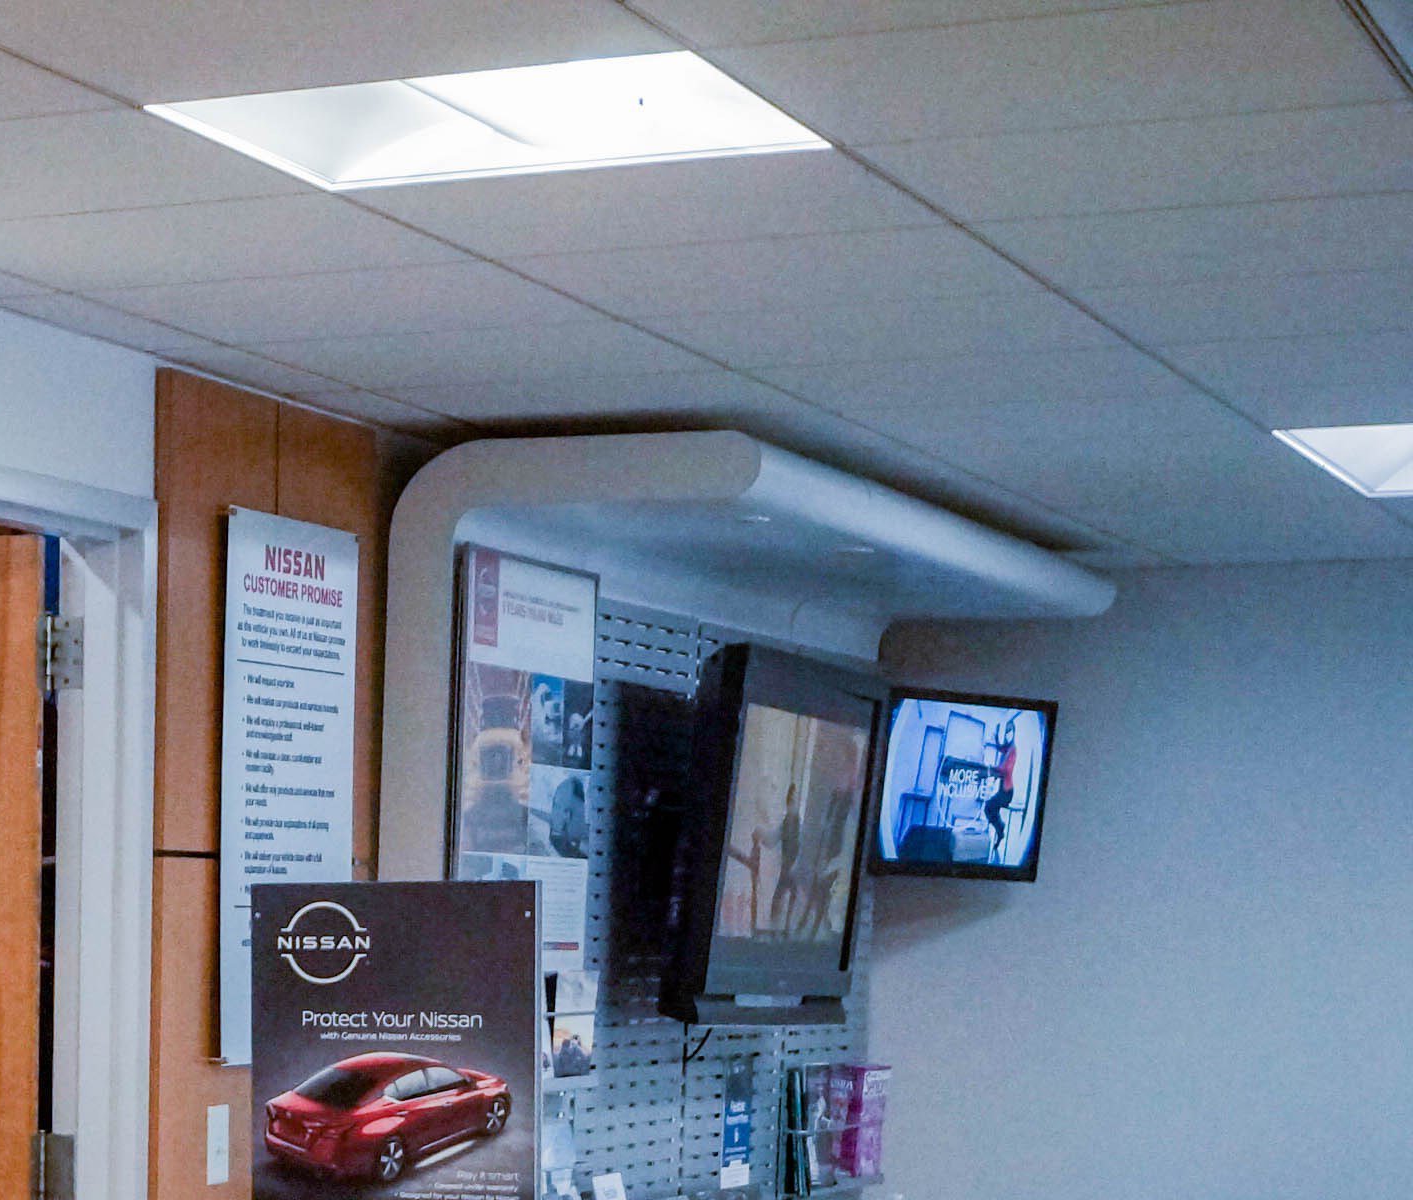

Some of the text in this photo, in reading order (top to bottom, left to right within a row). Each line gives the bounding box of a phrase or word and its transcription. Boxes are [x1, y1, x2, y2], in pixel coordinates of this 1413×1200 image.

[265, 544, 325, 581] NISSAN
[243, 573, 343, 608] CUSTOMER PROMISE
[949, 768, 980, 785] MORE
[277, 935, 371, 950] NISSAN
[302, 1010, 483, 1029] Protect Your Nissan
[320, 1031, 462, 1042] with Genuine Nissan Accessories
